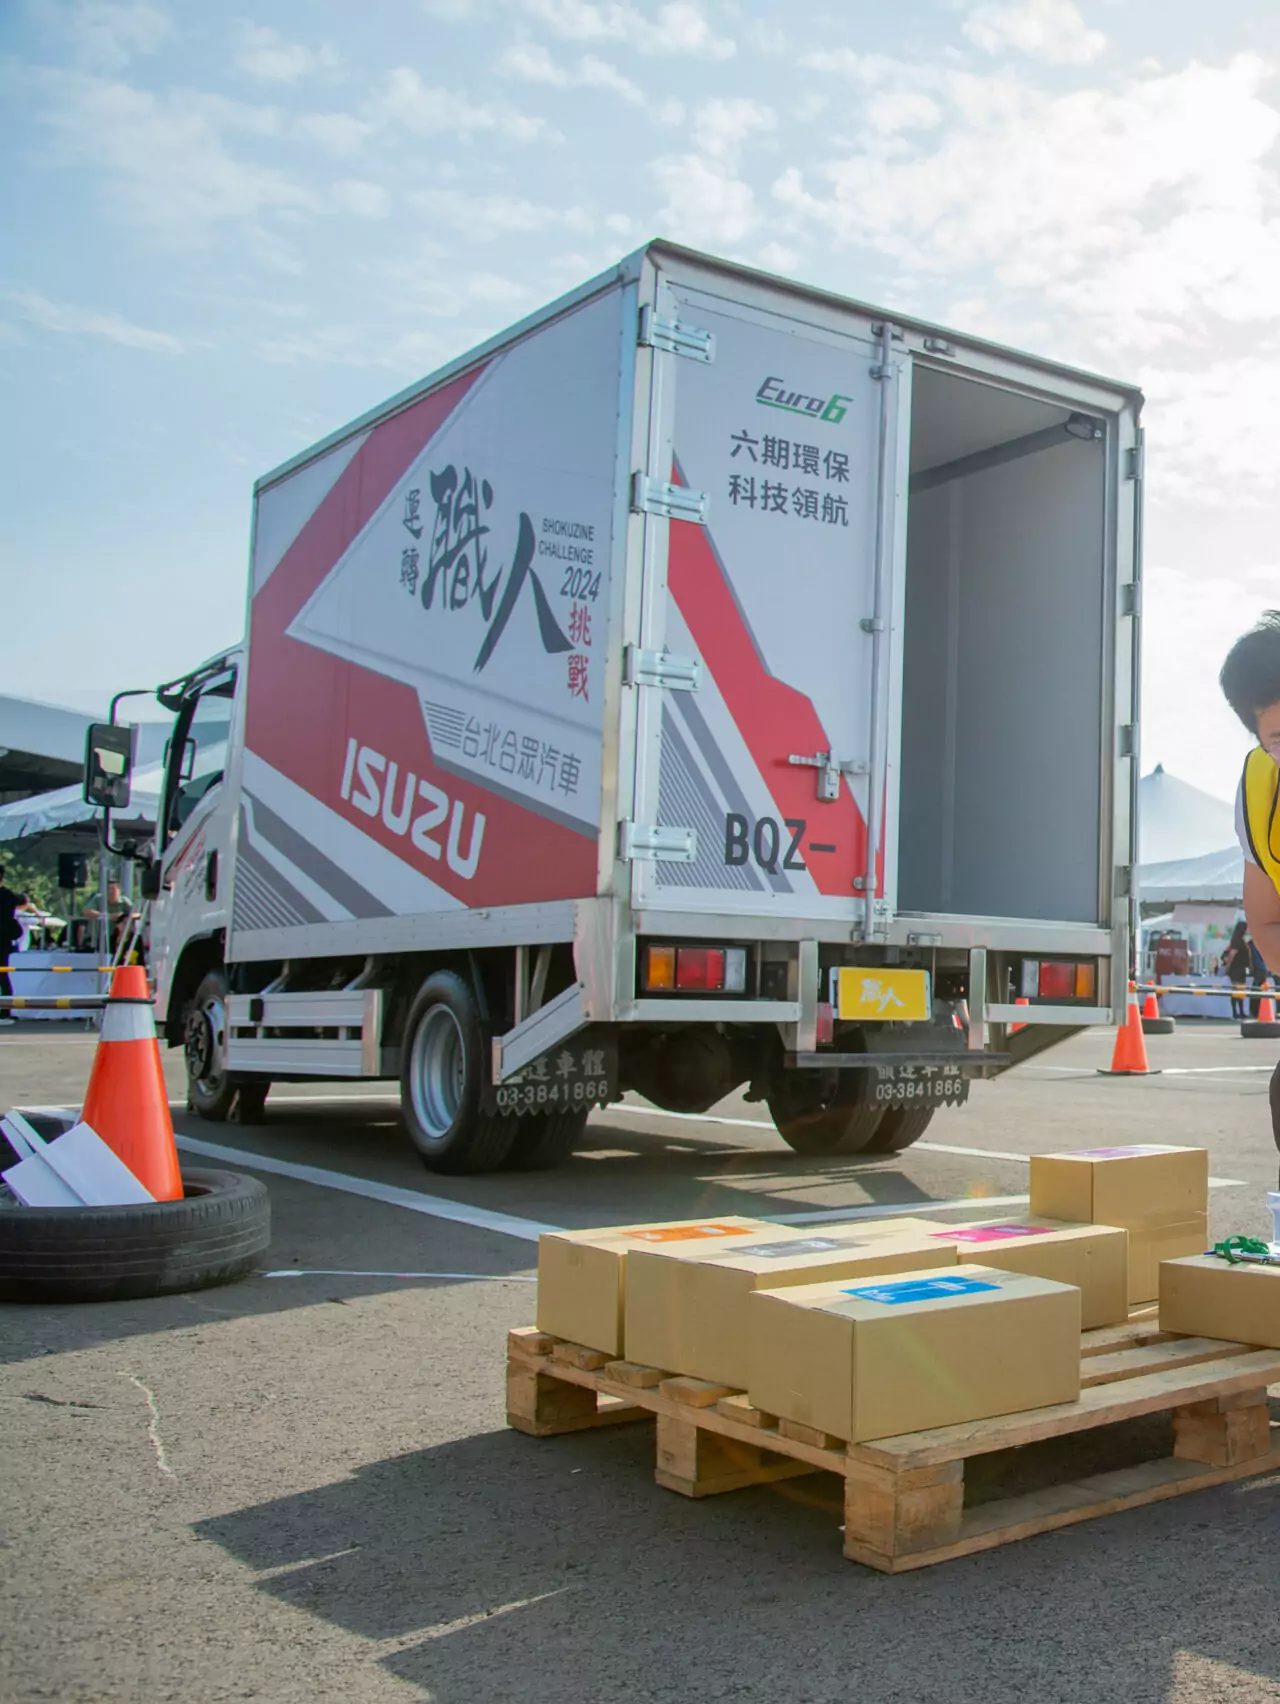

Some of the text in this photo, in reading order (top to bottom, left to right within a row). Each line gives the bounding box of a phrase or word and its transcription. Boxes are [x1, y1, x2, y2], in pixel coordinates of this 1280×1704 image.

[756, 376, 854, 424] Euro6
[730, 429, 850, 483] 六期環保
[728, 474, 849, 527] 科技領航
[538, 540, 594, 565] CHALLENGE
[542, 517, 595, 542] SHOKUZINE
[560, 566, 602, 602] 2024
[567, 602, 592, 703] 挑戰
[462, 716, 582, 797] 台北合眾汽車
[340, 737, 486, 880] ISUZU
[496, 1080, 608, 1107] 03-3841866
[876, 1078, 962, 1100] 03-3841866
